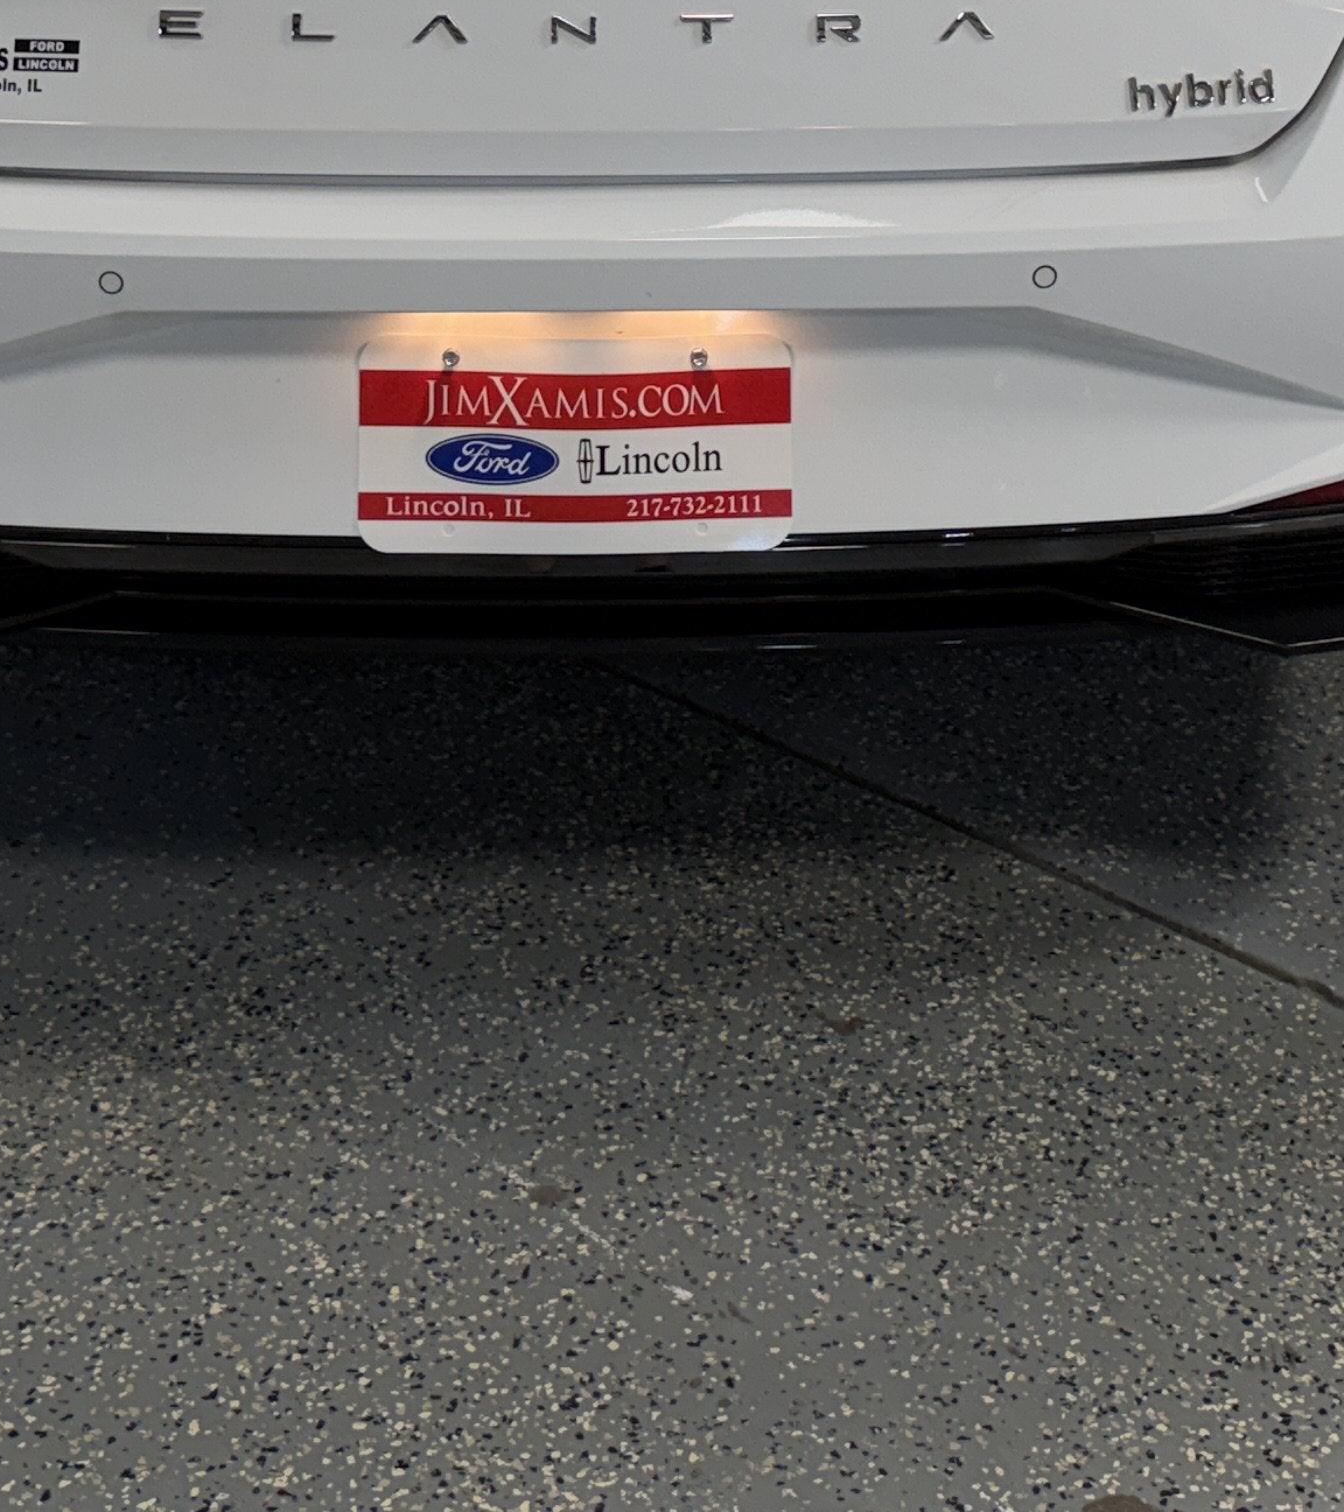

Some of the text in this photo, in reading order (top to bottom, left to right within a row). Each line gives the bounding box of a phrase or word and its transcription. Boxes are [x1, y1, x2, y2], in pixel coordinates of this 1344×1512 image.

[159, 10, 992, 44] ELANTRA
[29, 40, 65, 52] FORD
[17, 59, 75, 71] LINCOLN
[27, 78, 43, 93] IL
[1128, 69, 1274, 117] hybrid
[423, 376, 725, 426] JIMXAMIS.COM
[453, 440, 532, 476] Ford
[596, 442, 722, 475] Lincoln
[386, 496, 532, 519] Lincoln, IL
[626, 495, 762, 518] 217-732-2111
